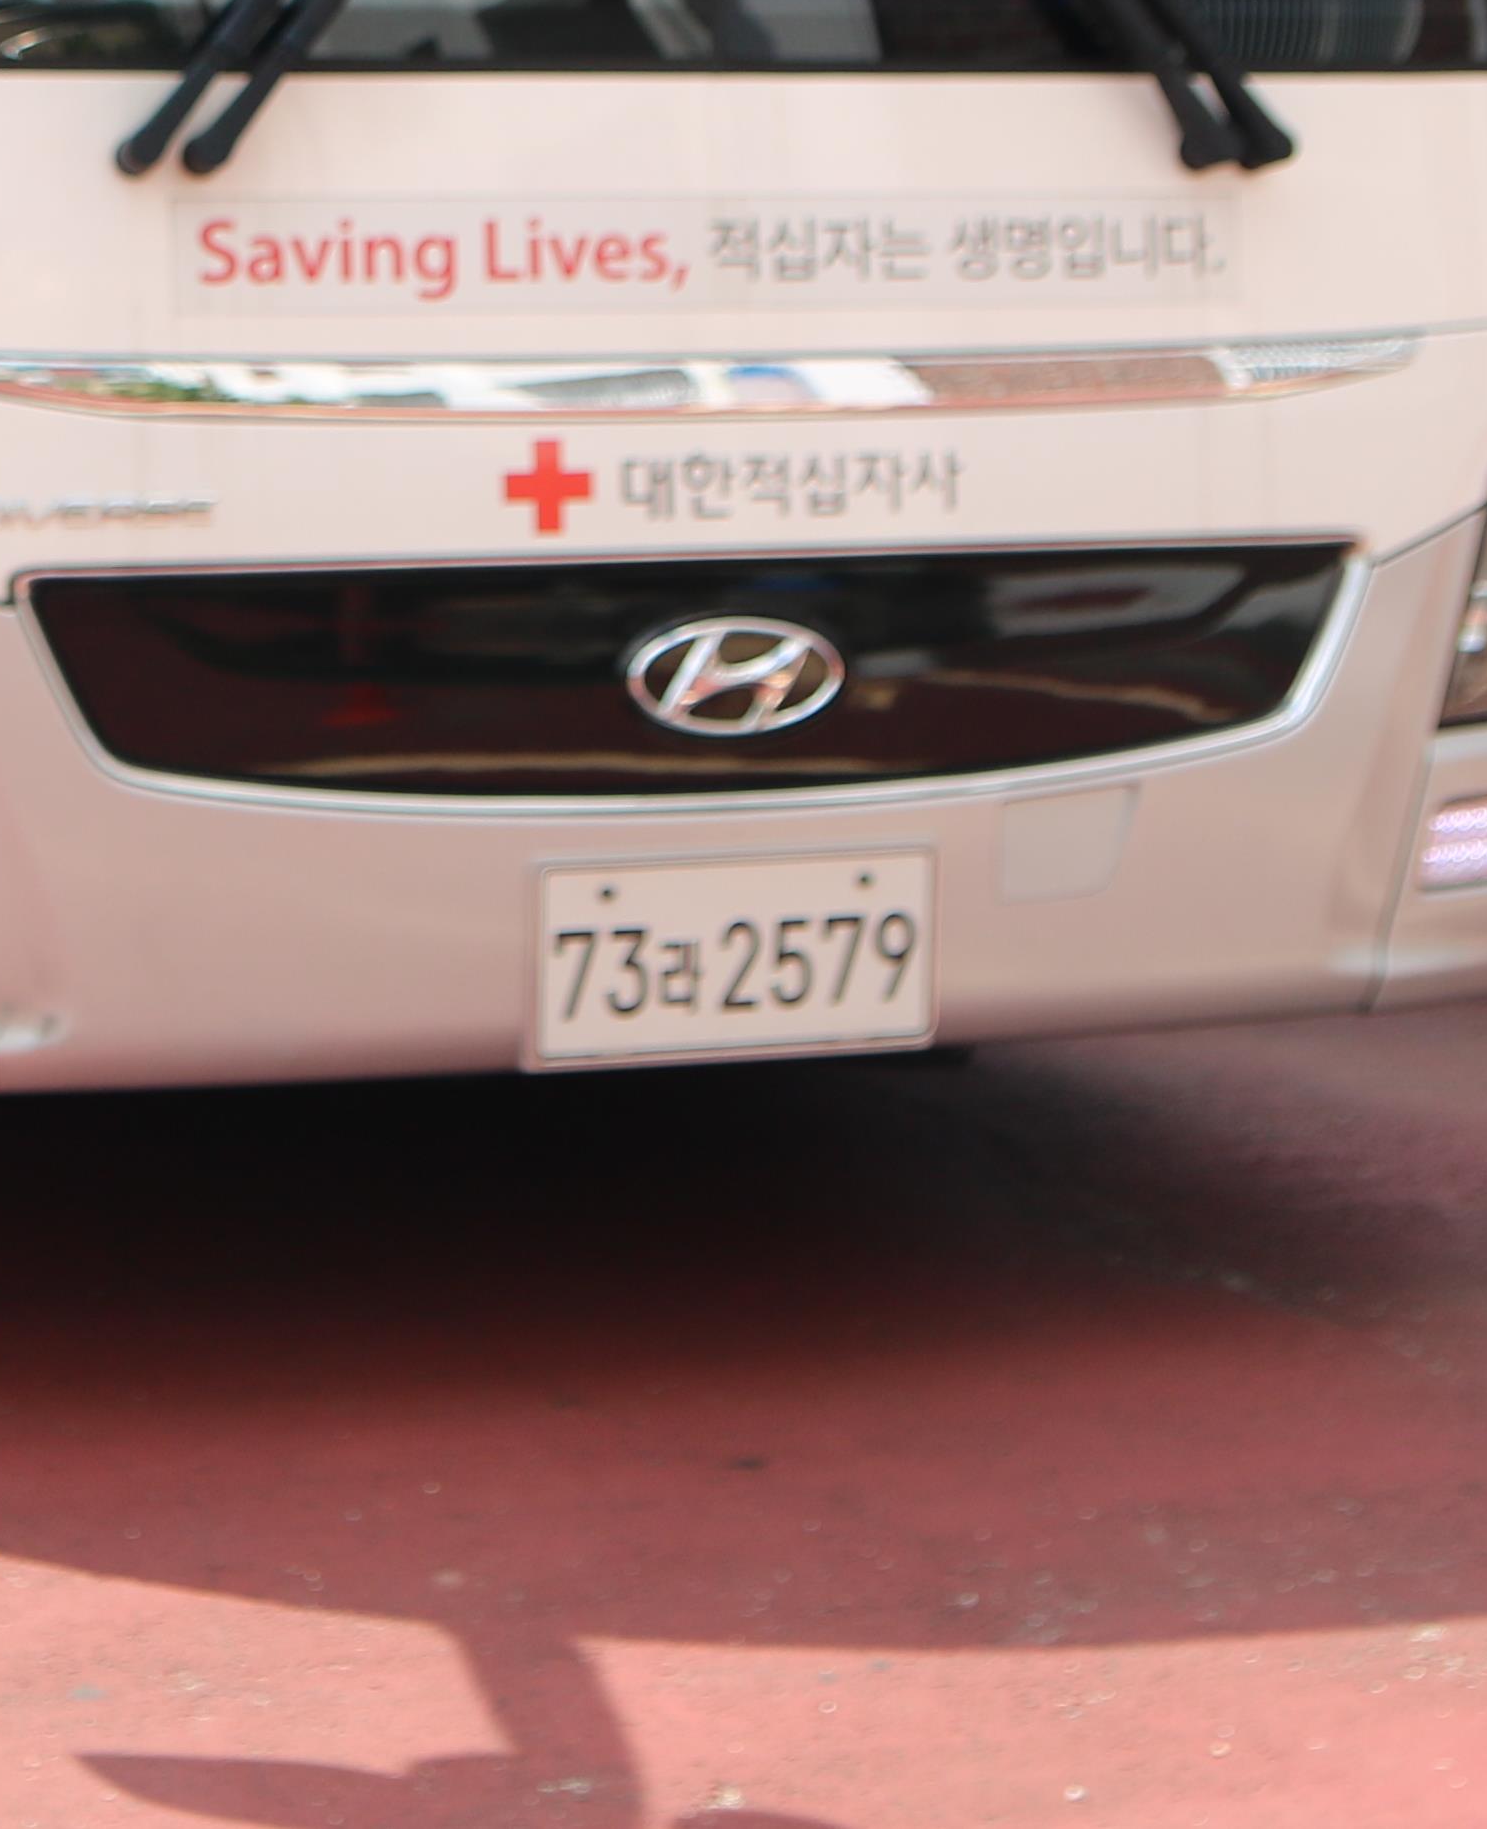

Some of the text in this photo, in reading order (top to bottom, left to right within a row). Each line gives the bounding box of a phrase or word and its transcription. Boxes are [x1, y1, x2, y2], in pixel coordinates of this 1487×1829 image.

[197, 212, 1227, 302] Saving Lives, 적십자는 생명입니다.
[619, 448, 966, 521] 대한적십자사
[551, 911, 919, 1022] 73라2579
